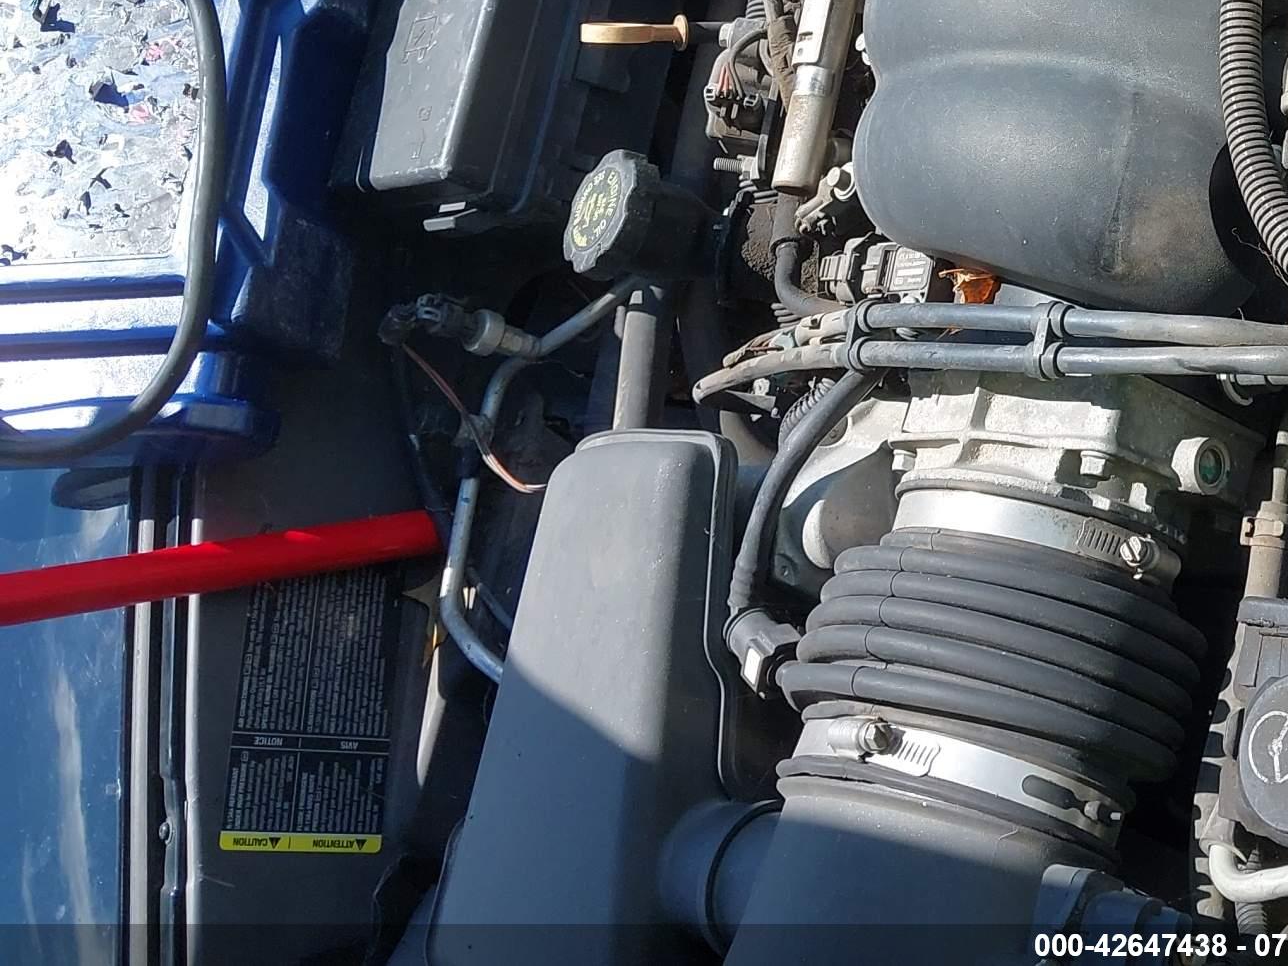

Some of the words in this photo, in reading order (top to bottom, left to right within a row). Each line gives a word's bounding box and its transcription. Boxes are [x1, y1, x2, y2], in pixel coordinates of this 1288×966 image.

[254, 736, 283, 746] NOTICE
[340, 740, 359, 750] AVIS
[232, 837, 268, 847] CAUTION
[312, 838, 355, 849] ATTENTION
